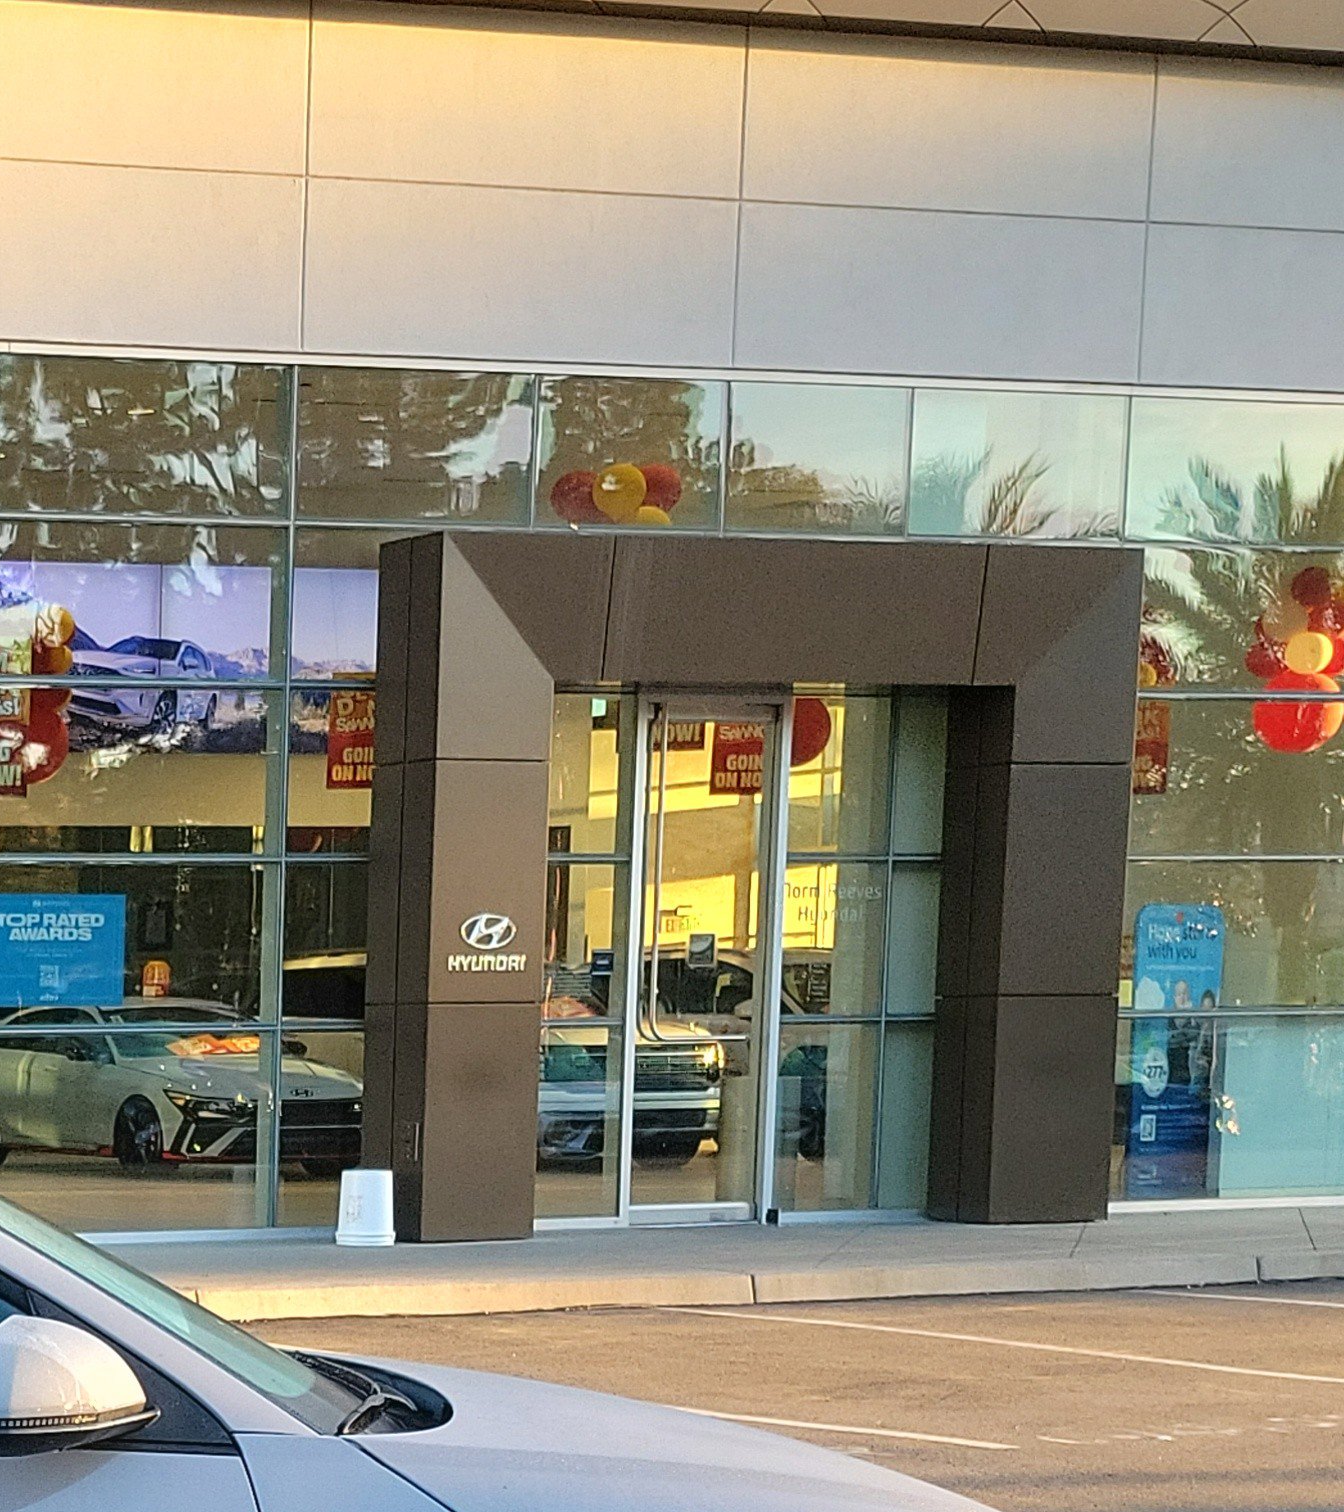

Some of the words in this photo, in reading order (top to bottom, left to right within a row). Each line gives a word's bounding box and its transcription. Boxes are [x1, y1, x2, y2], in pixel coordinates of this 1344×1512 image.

[725, 754, 763, 771] GOIN
[332, 764, 354, 782] ON
[715, 772, 738, 789] ON
[740, 772, 763, 788] NO
[42, 913, 105, 928] RATED
[8, 927, 93, 941] AWARDS
[1175, 945, 1198, 962] you
[447, 953, 527, 972] HYUNDAI
